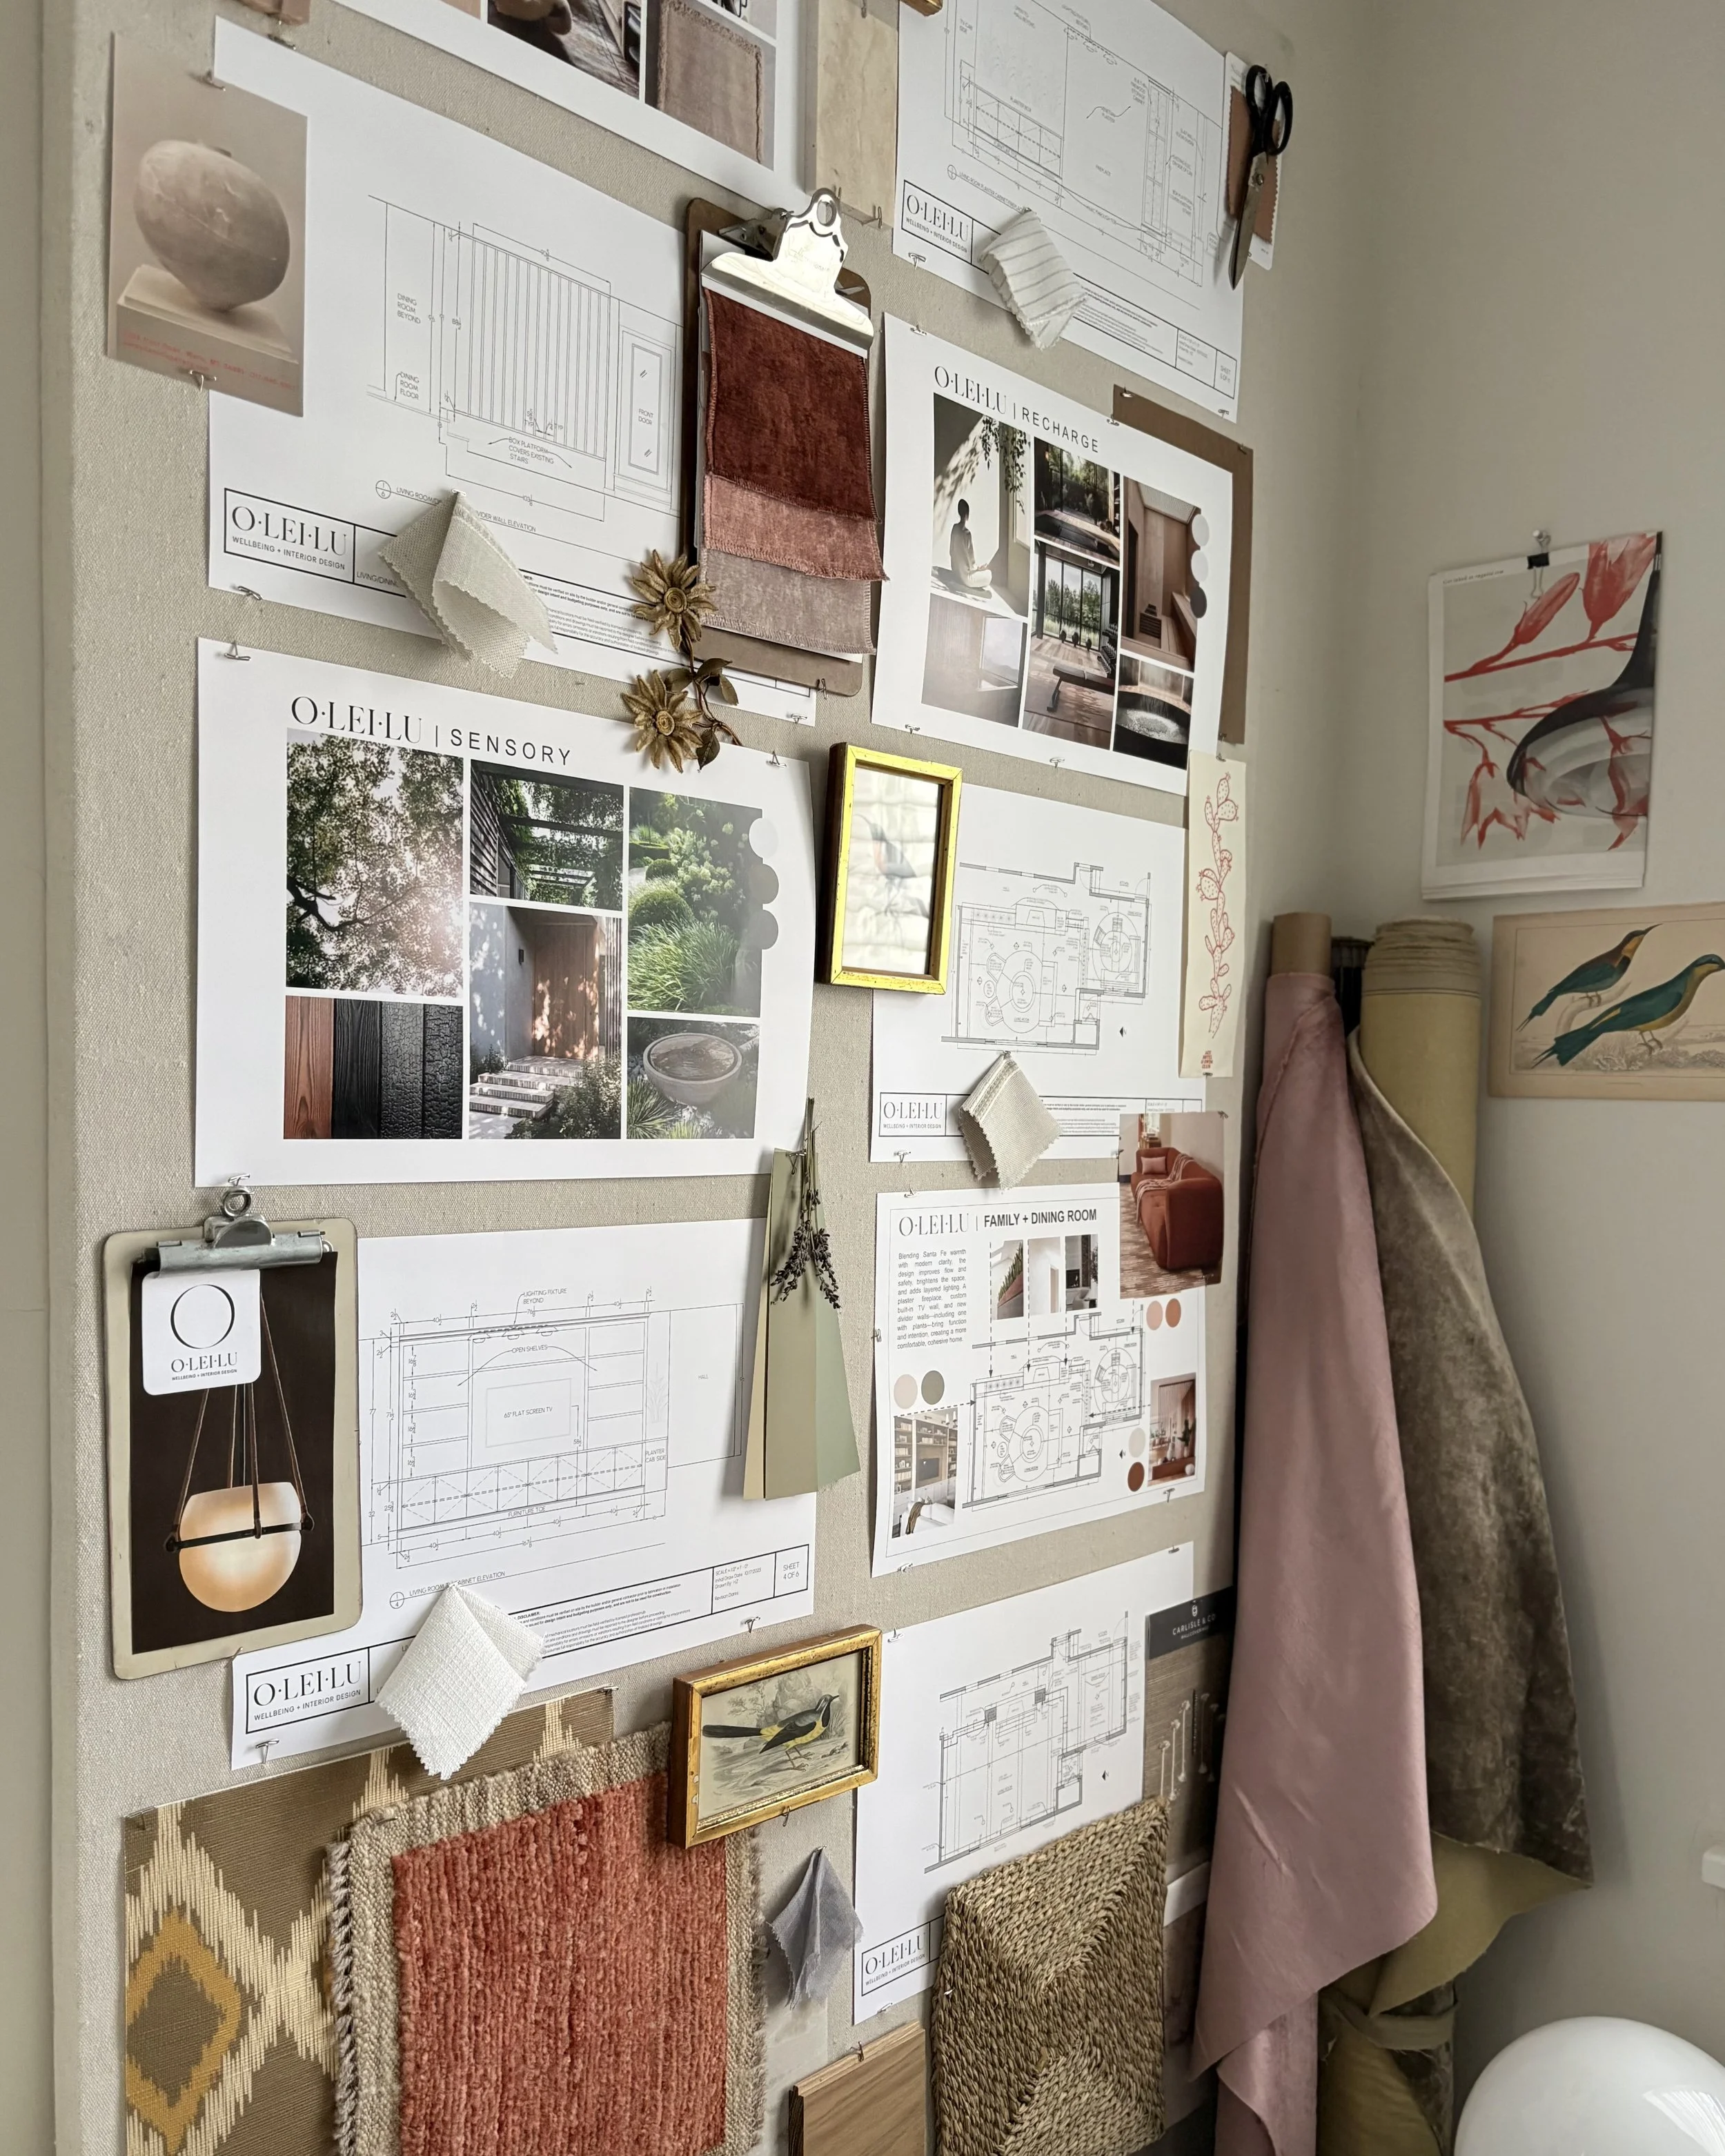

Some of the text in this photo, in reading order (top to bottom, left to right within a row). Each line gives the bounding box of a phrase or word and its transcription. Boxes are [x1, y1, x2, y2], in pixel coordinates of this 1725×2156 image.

[906, 217, 967, 253] WELLBEING INTERIOR DESIGN
[397, 301, 416, 314] ROOM
[397, 310, 420, 324] BEYOND
[400, 380, 418, 391] ROOM
[400, 388, 419, 400] FLOOR
[638, 408, 653, 419] FRONT
[934, 366, 1098, 453] O·LEI·LU RECHARGE
[638, 416, 653, 425] DOOR
[509, 437, 549, 453] BOX PLATFORM
[509, 445, 554, 464] COVERS EXISTING
[510, 454, 529, 464] STAIRS
[396, 487, 414, 497] LIVING
[232, 506, 346, 556] O·LEI·LU
[493, 515, 507, 526] WALL
[507, 519, 536, 533] ELEVATION
[232, 535, 275, 553] WELLBEING
[283, 548, 317, 564] INTERIOR
[319, 557, 346, 571] DESIGN
[291, 695, 571, 766] O·LEI·LU SENSORY
[883, 1102, 943, 1119] O·LEI·LU
[899, 1209, 1096, 1236] O·LEI·LU FAMILY + DINING ROOM
[923, 1285, 941, 1294] layered
[897, 1341, 927, 1349] comfortable,
[171, 1352, 237, 1373] O·LEI·LU
[645, 1447, 665, 1456] PLANTER
[508, 1509, 534, 1517] FURNITURE
[716, 1567, 727, 1576] SCALE
[782, 1561, 800, 1572] SHEET
[477, 1571, 506, 1582] ELEVATION
[409, 1584, 444, 1596] LIVING ROOM
[1172, 1619, 1201, 1636] CARLISLE
[253, 1661, 362, 1706] O·LEI·LU
[254, 1705, 295, 1721] WELLBEING
[302, 1696, 334, 1709] INTERIOR
[336, 1689, 362, 1701] DESIGN
[865, 1953, 925, 1986] WELLBEING INTERIOR DESIGN
